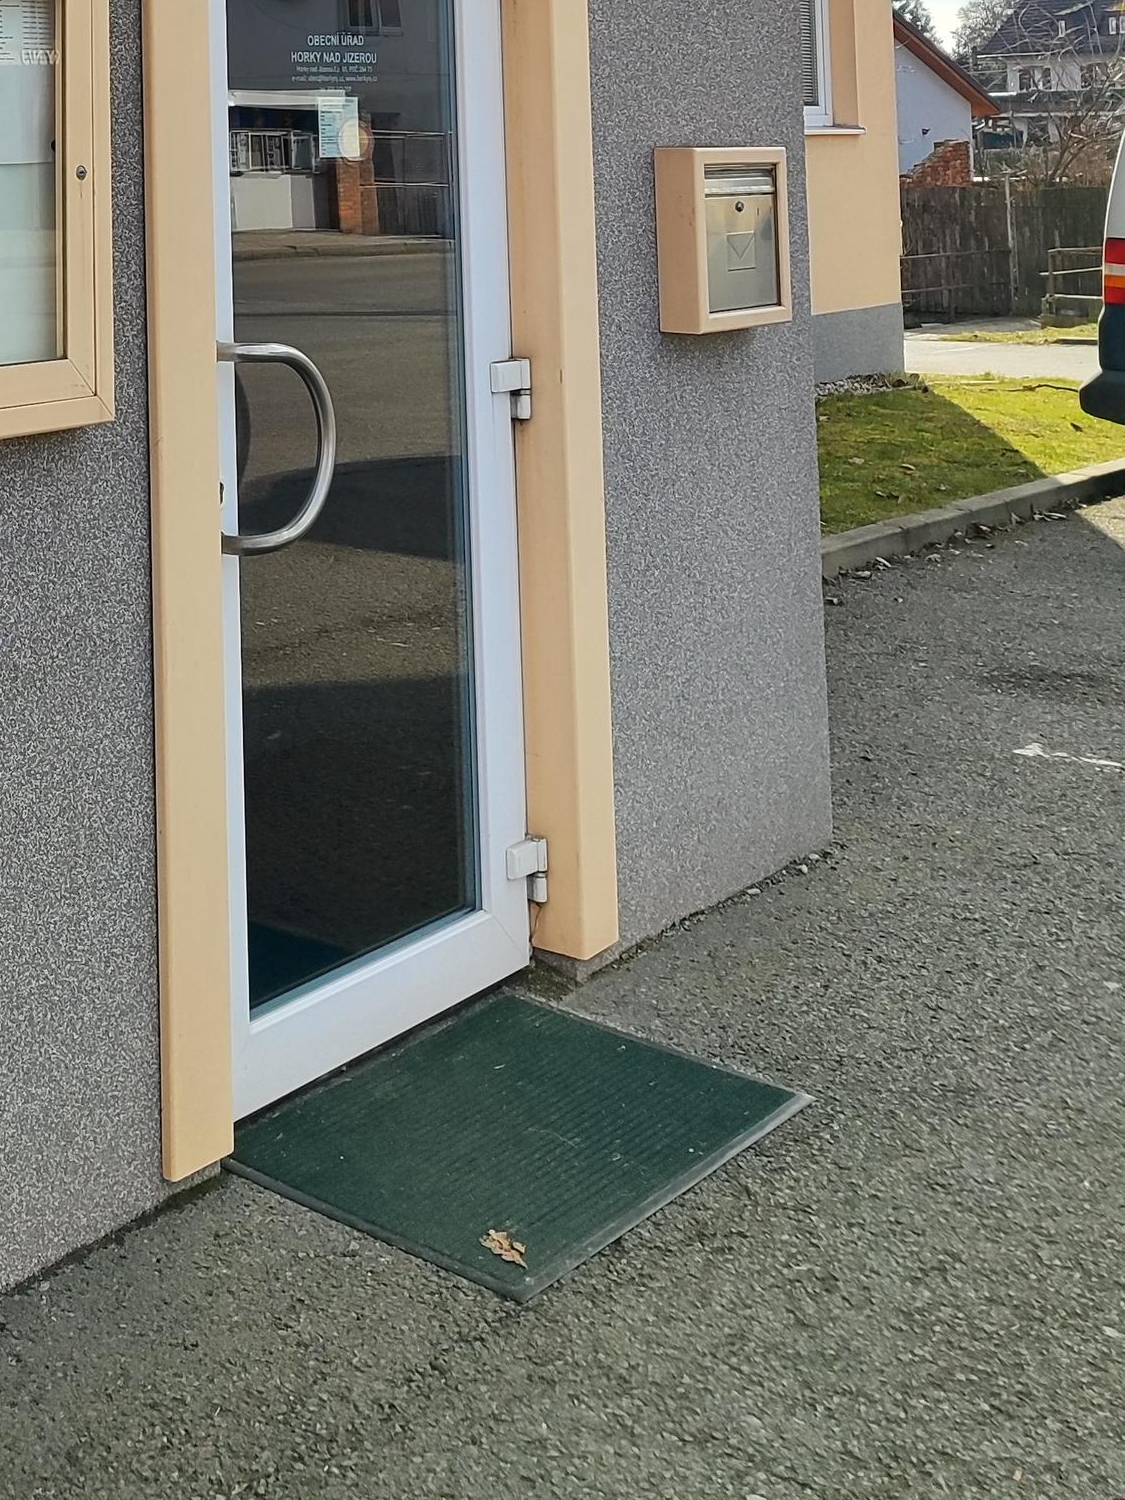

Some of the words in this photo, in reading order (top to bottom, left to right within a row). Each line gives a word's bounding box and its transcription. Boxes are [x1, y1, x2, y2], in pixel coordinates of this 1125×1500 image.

[307, 32, 339, 46] OBECNÍ
[291, 51, 322, 63] HORKY
[323, 52, 341, 63] NAD
[342, 52, 377, 64] JIZEROU
